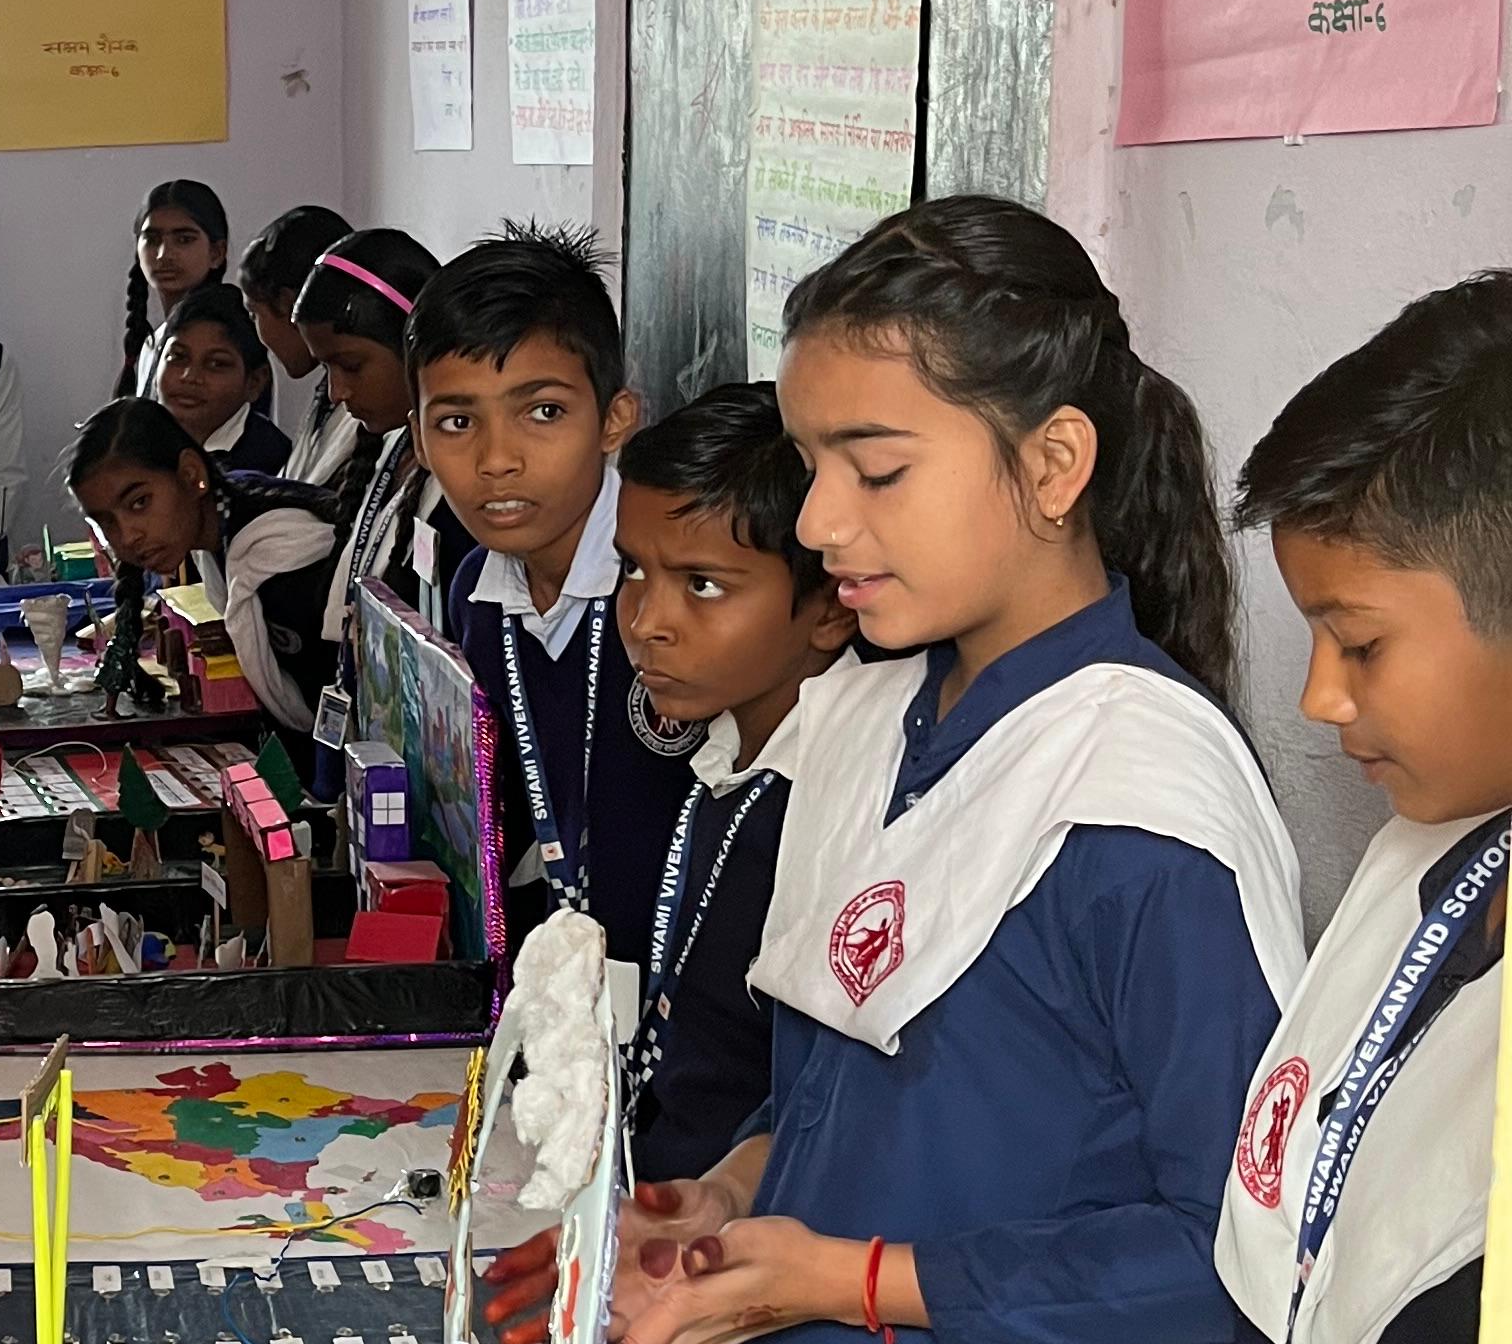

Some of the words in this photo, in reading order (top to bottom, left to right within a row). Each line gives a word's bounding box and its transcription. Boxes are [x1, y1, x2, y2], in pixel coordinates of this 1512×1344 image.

[503, 634, 533, 756] VIVEKANAND
[524, 759, 548, 821] SWAMI
[660, 778, 703, 899] VIVEKANAN
[699, 787, 761, 907] VIVEKANAND
[651, 904, 672, 974] SWAMI
[1304, 1121, 1343, 1224] SWAMI
[1336, 921, 1450, 1111] VIVEKANAND
[1322, 1116, 1365, 1218] SWAMI
